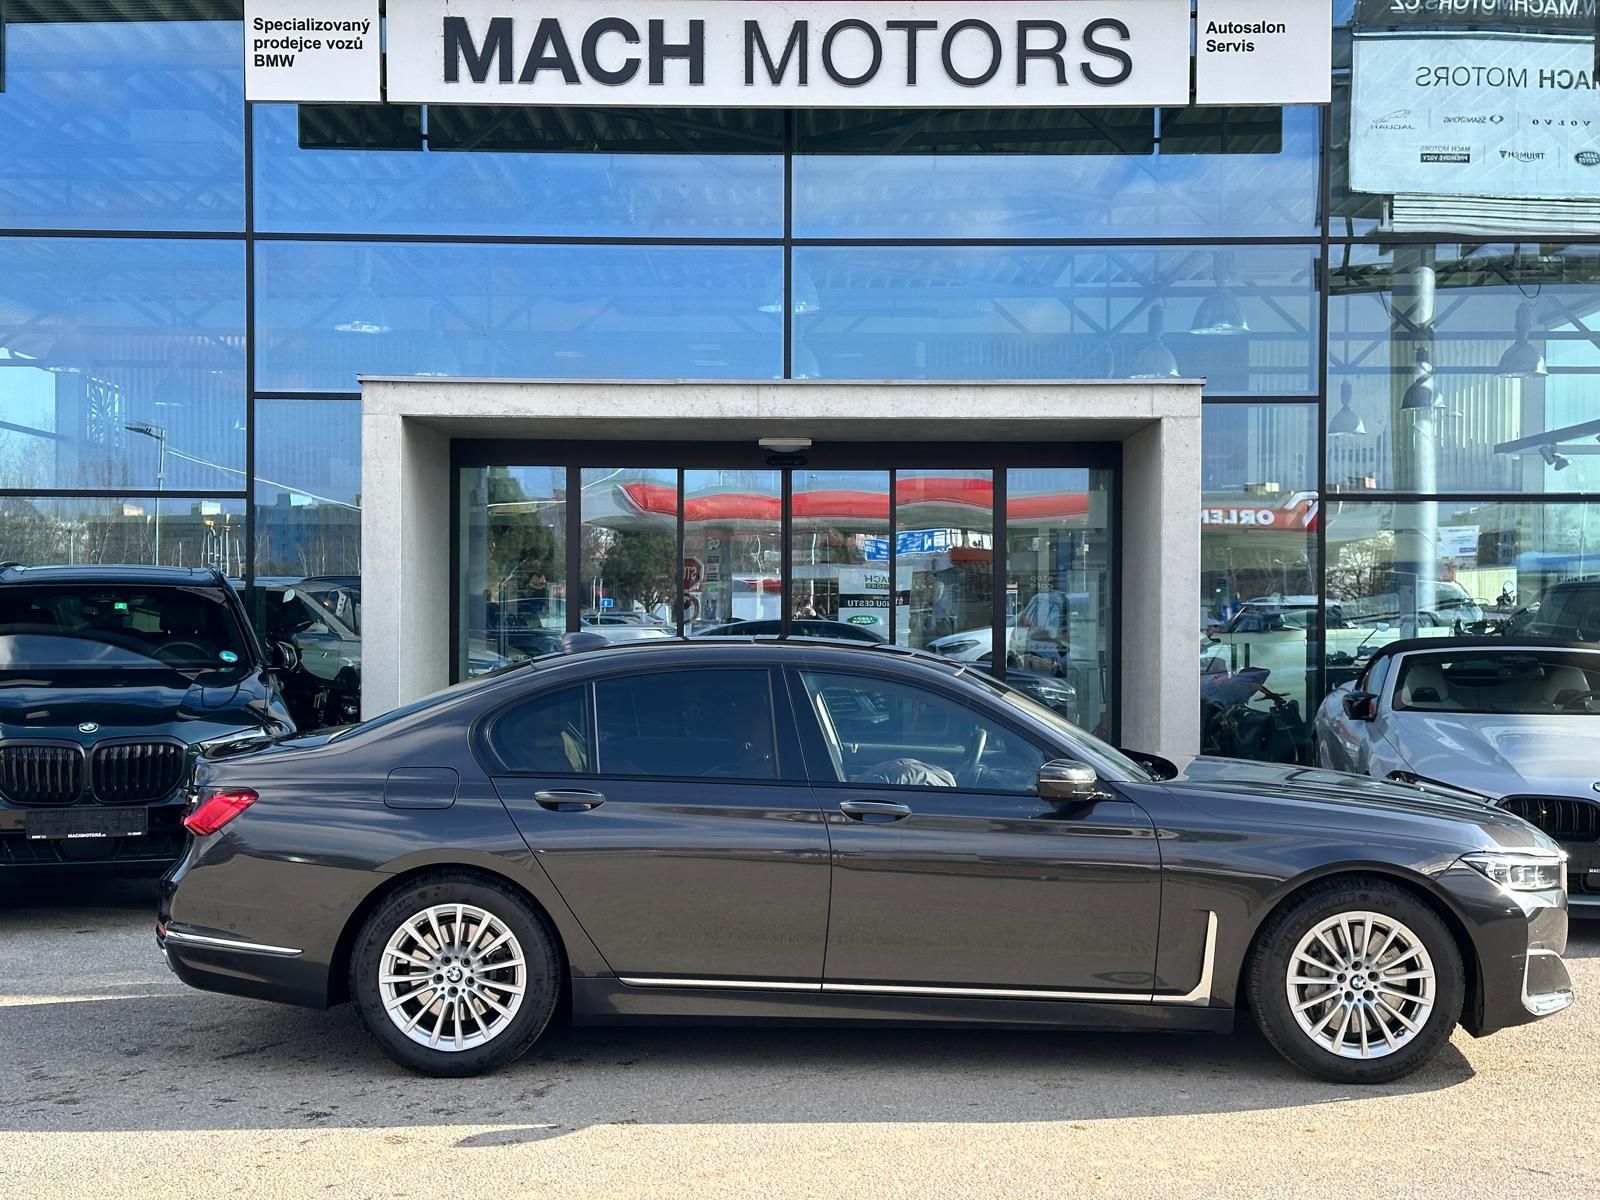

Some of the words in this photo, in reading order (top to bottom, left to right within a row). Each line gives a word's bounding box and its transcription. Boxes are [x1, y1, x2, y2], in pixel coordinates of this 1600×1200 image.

[253, 17, 370, 34] Specializovaný
[1206, 20, 1286, 34] Autosalon
[253, 36, 322, 52] prodejce
[326, 36, 363, 50] vozů
[1206, 39, 1255, 52] Servis
[443, 17, 704, 86] MACH
[743, 18, 1134, 87] MOTORS
[254, 54, 295, 68] BMW
